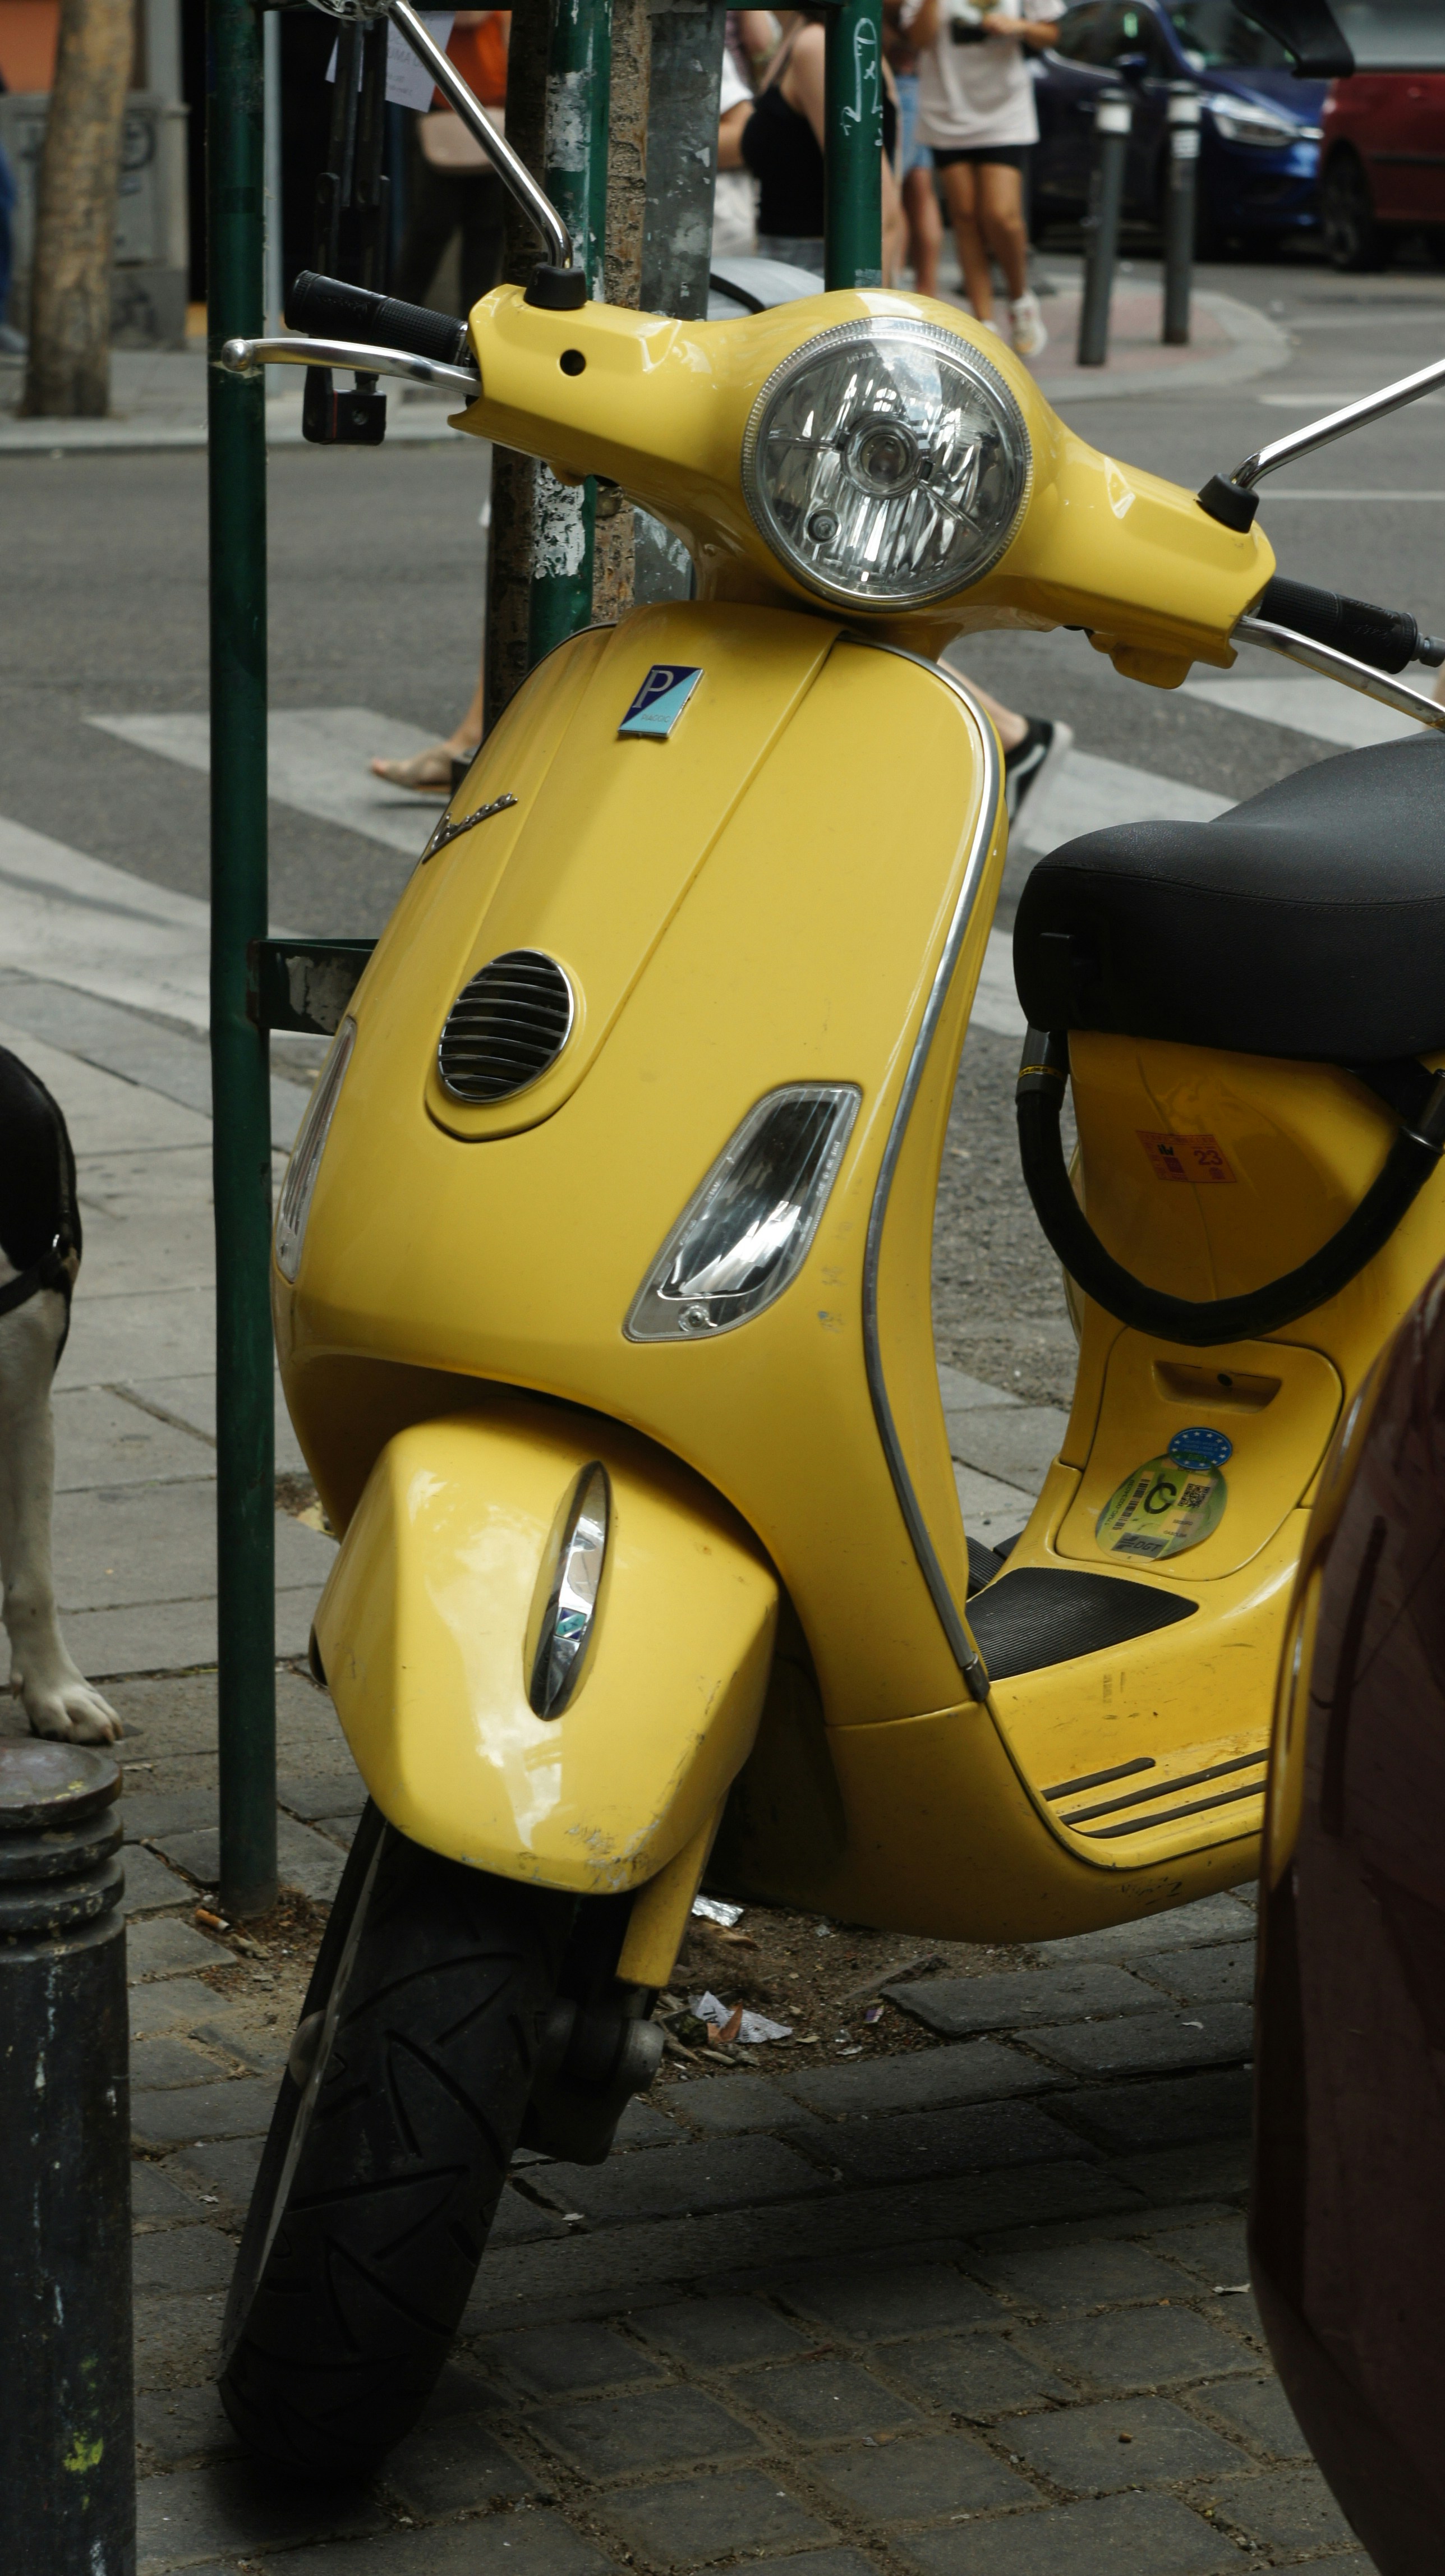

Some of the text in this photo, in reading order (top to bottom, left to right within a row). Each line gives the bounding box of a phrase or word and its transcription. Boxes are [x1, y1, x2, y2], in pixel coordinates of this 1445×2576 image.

[632, 669, 674, 708] P
[641, 714, 671, 723] PIAGGIO
[1193, 1149, 1223, 1166] 23
[1144, 1482, 1177, 1515] C
[1133, 1541, 1163, 1552] DGT
[563, 1618, 580, 1632] LX
